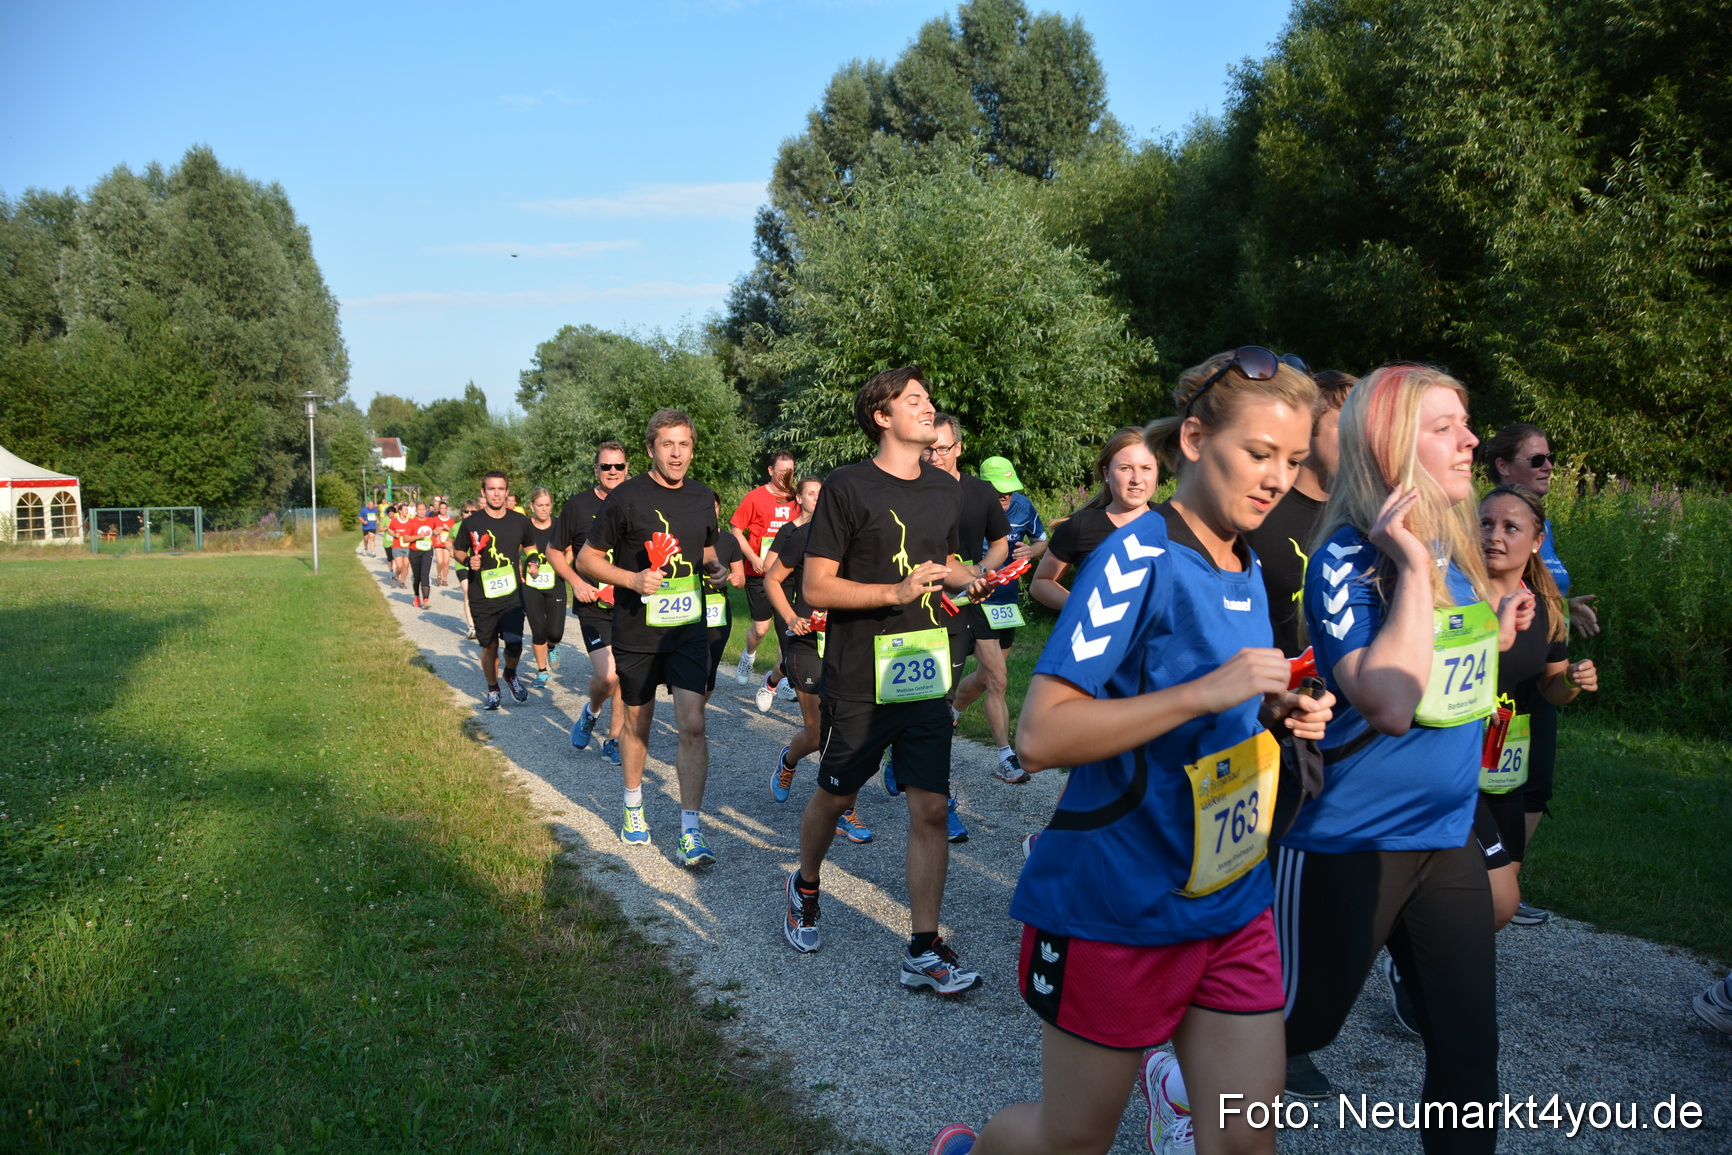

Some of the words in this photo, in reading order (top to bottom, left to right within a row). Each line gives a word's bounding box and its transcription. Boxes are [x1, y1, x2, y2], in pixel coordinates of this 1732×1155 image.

[490, 578, 509, 590] 251
[658, 596, 692, 614] 249
[991, 606, 1014, 620] 953
[892, 658, 936, 685] 238
[1444, 648, 1487, 695] 724
[1487, 747, 1523, 774] 26
[829, 775, 839, 787] TR
[1214, 789, 1259, 855] 763
